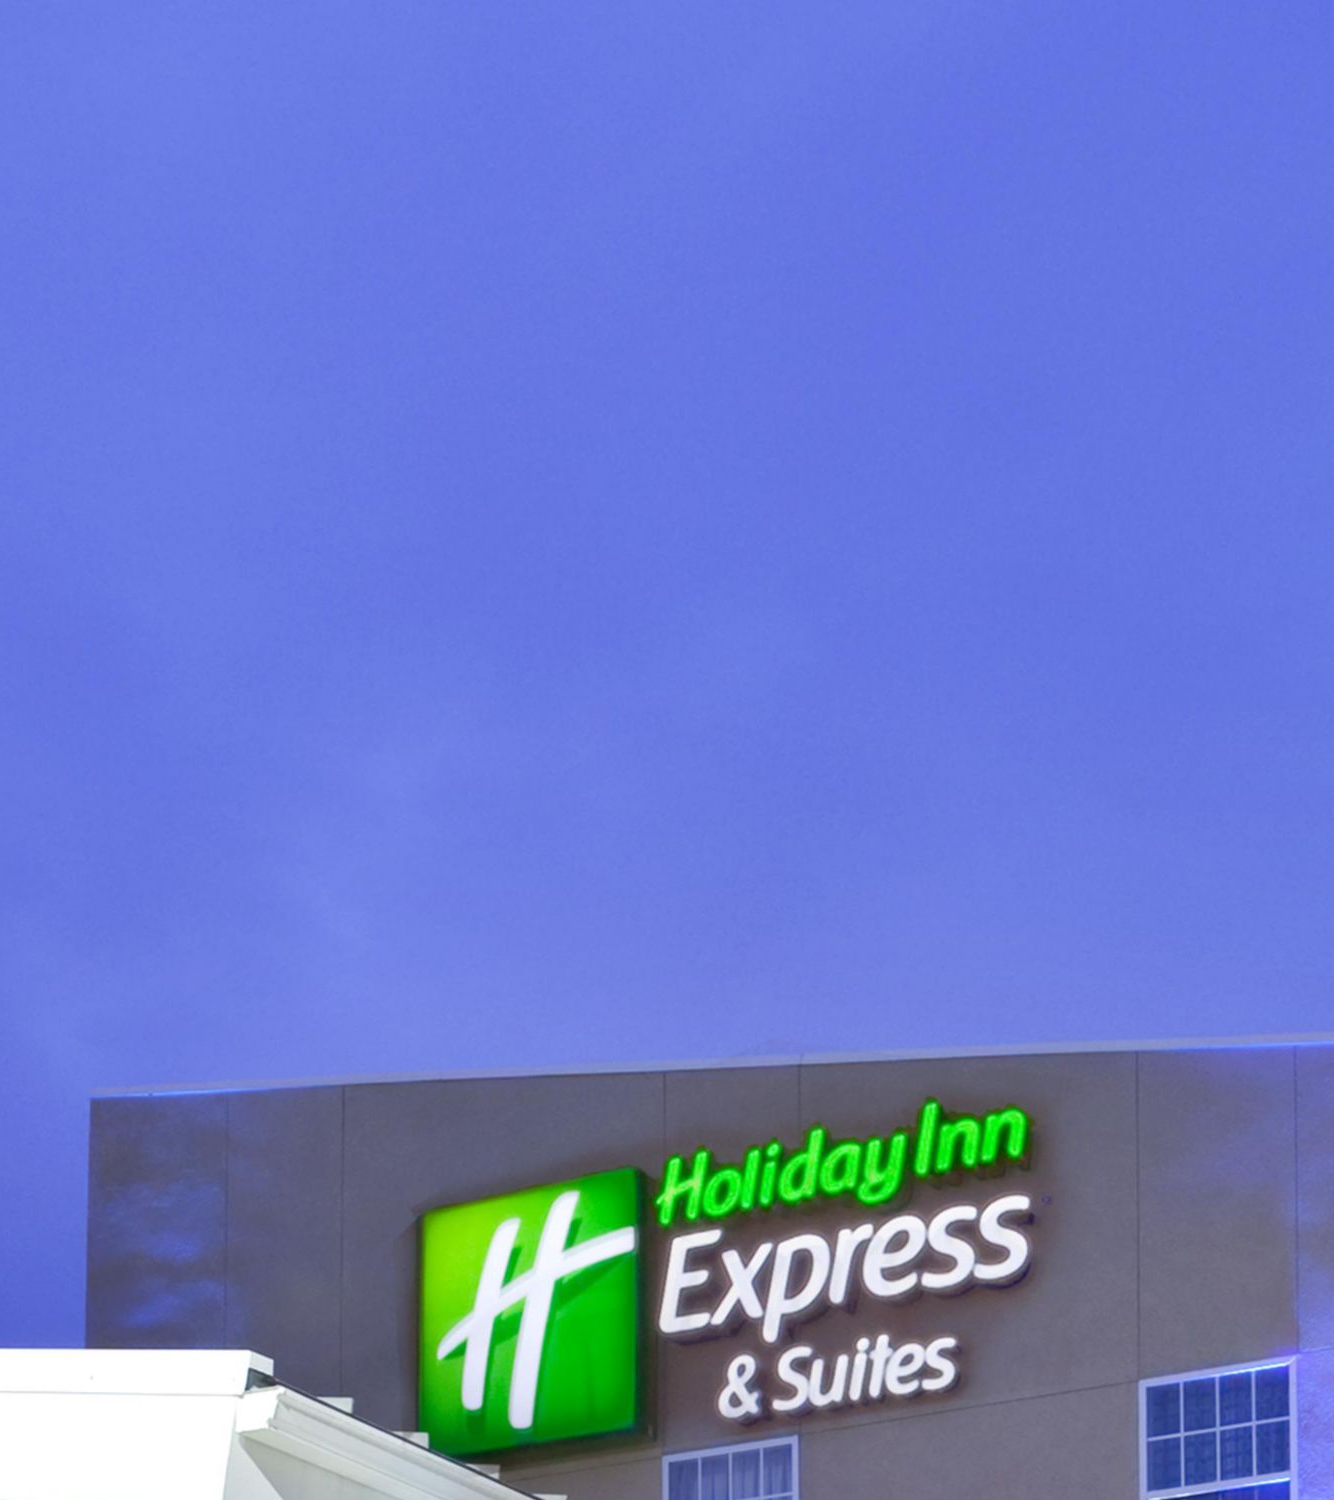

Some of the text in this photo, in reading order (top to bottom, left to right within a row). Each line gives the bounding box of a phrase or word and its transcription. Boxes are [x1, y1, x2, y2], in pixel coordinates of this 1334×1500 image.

[658, 1099, 1029, 1225] Holiday Inn
[658, 1194, 1032, 1343] Express
[717, 1333, 958, 1420] & Suites
